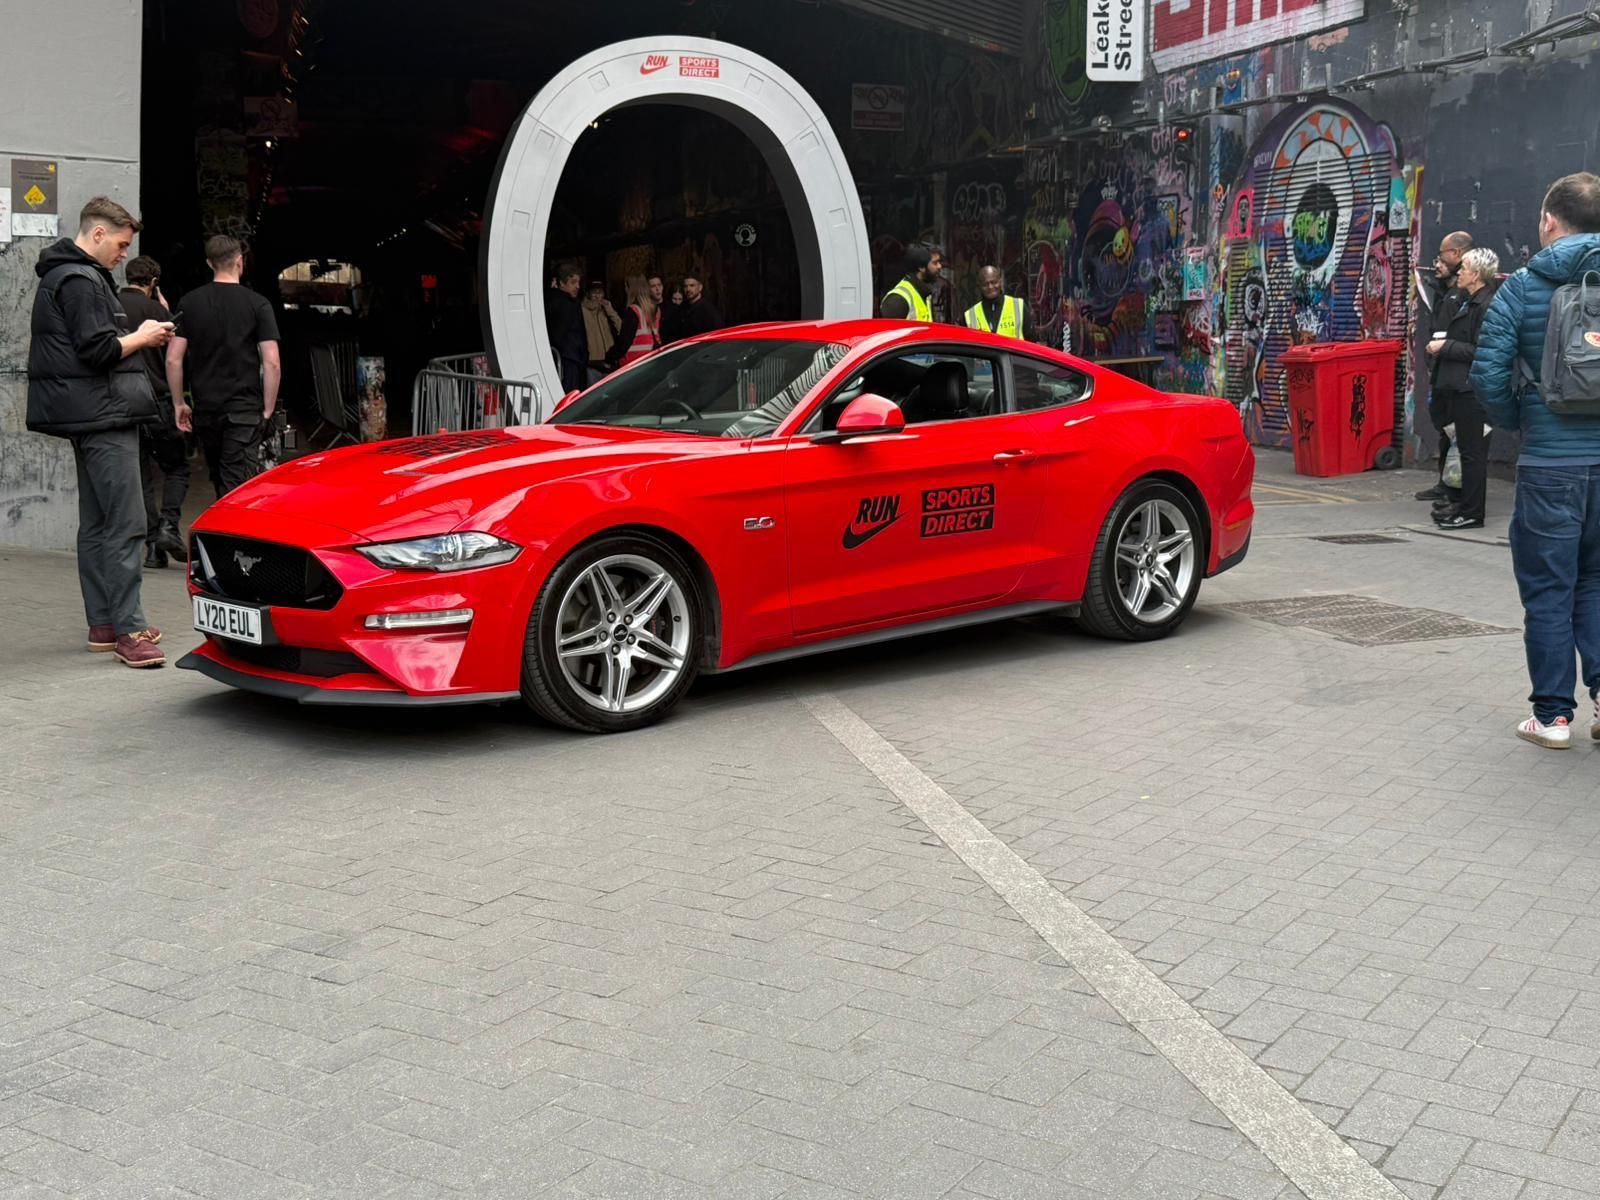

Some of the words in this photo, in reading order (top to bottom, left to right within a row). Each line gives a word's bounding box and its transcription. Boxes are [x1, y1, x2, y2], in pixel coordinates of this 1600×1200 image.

[1091, 0, 1109, 69] Leak
[645, 55, 669, 67] RUN
[681, 57, 718, 68] SPORTS
[681, 67, 717, 77] DIRECT
[856, 495, 900, 525] RUN
[925, 485, 991, 510] SPORTS
[923, 510, 989, 535] DIRECT
[197, 600, 226, 631] LY20
[228, 608, 255, 638] EUL
